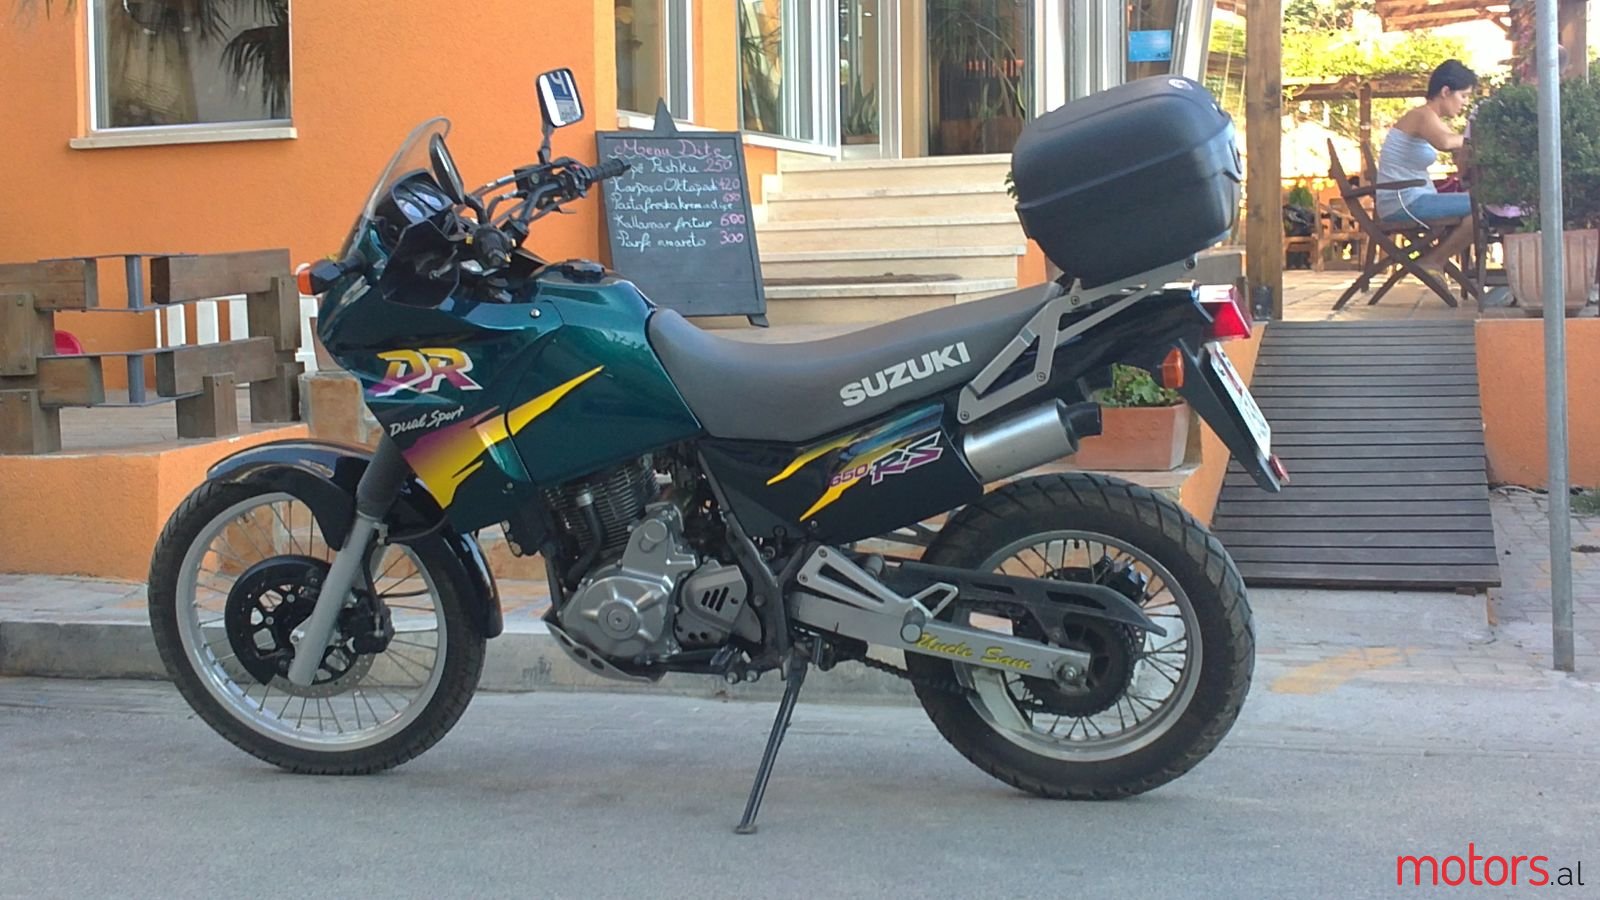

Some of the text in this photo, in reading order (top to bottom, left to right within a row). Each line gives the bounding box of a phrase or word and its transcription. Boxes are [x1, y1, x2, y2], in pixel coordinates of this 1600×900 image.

[614, 139, 670, 156] Menu
[651, 157, 698, 174] Peshku
[704, 159, 733, 173] 250
[720, 213, 745, 227] 600
[720, 230, 744, 244] 300
[367, 347, 483, 397] DR
[839, 341, 971, 407] SUZUKI
[830, 430, 943, 487] 650 RS
[914, 632, 1032, 670] Uncle Sam
